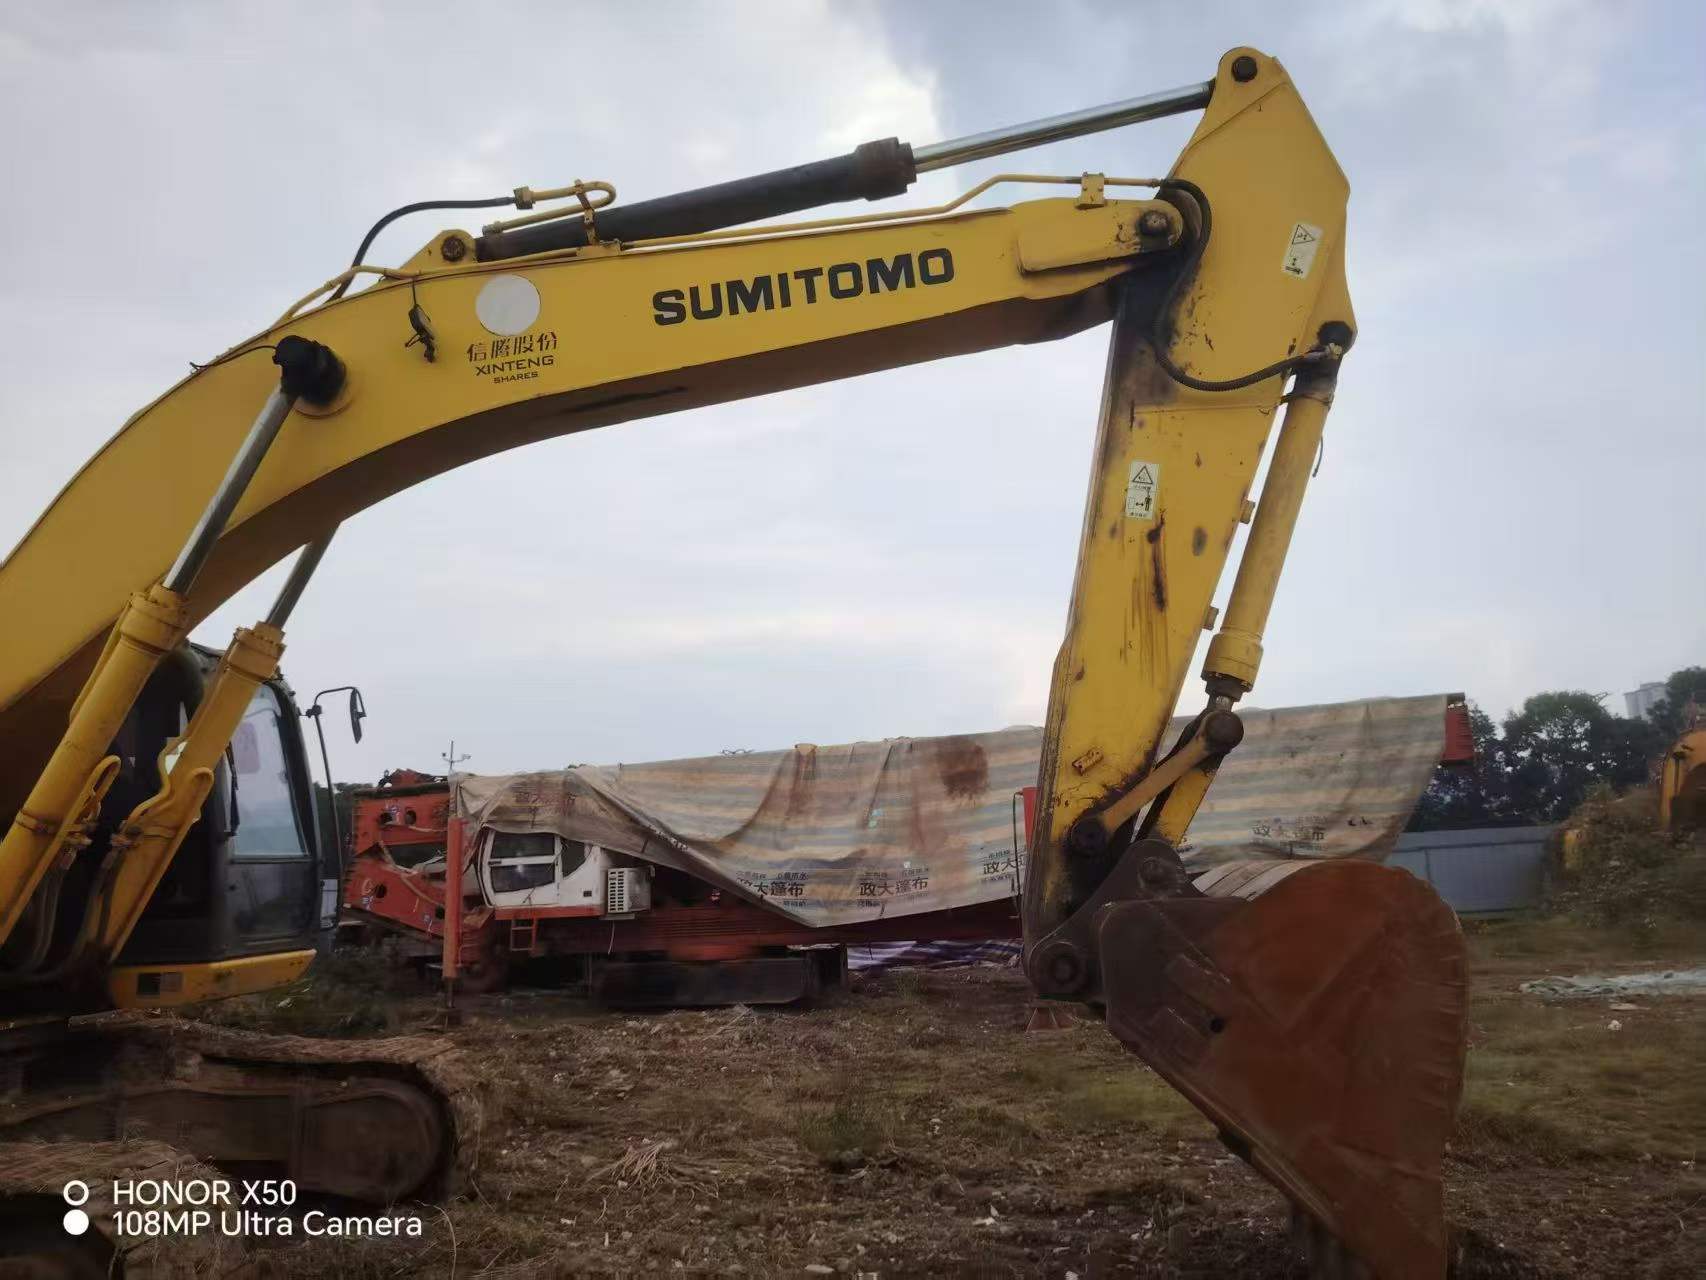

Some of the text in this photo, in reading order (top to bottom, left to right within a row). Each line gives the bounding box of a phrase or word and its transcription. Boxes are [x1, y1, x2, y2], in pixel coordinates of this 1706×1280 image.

[652, 248, 955, 326] SUMITOMO
[467, 331, 557, 362] 信腾股份
[476, 355, 554, 376] XINTENG
[493, 371, 538, 384] SHARES
